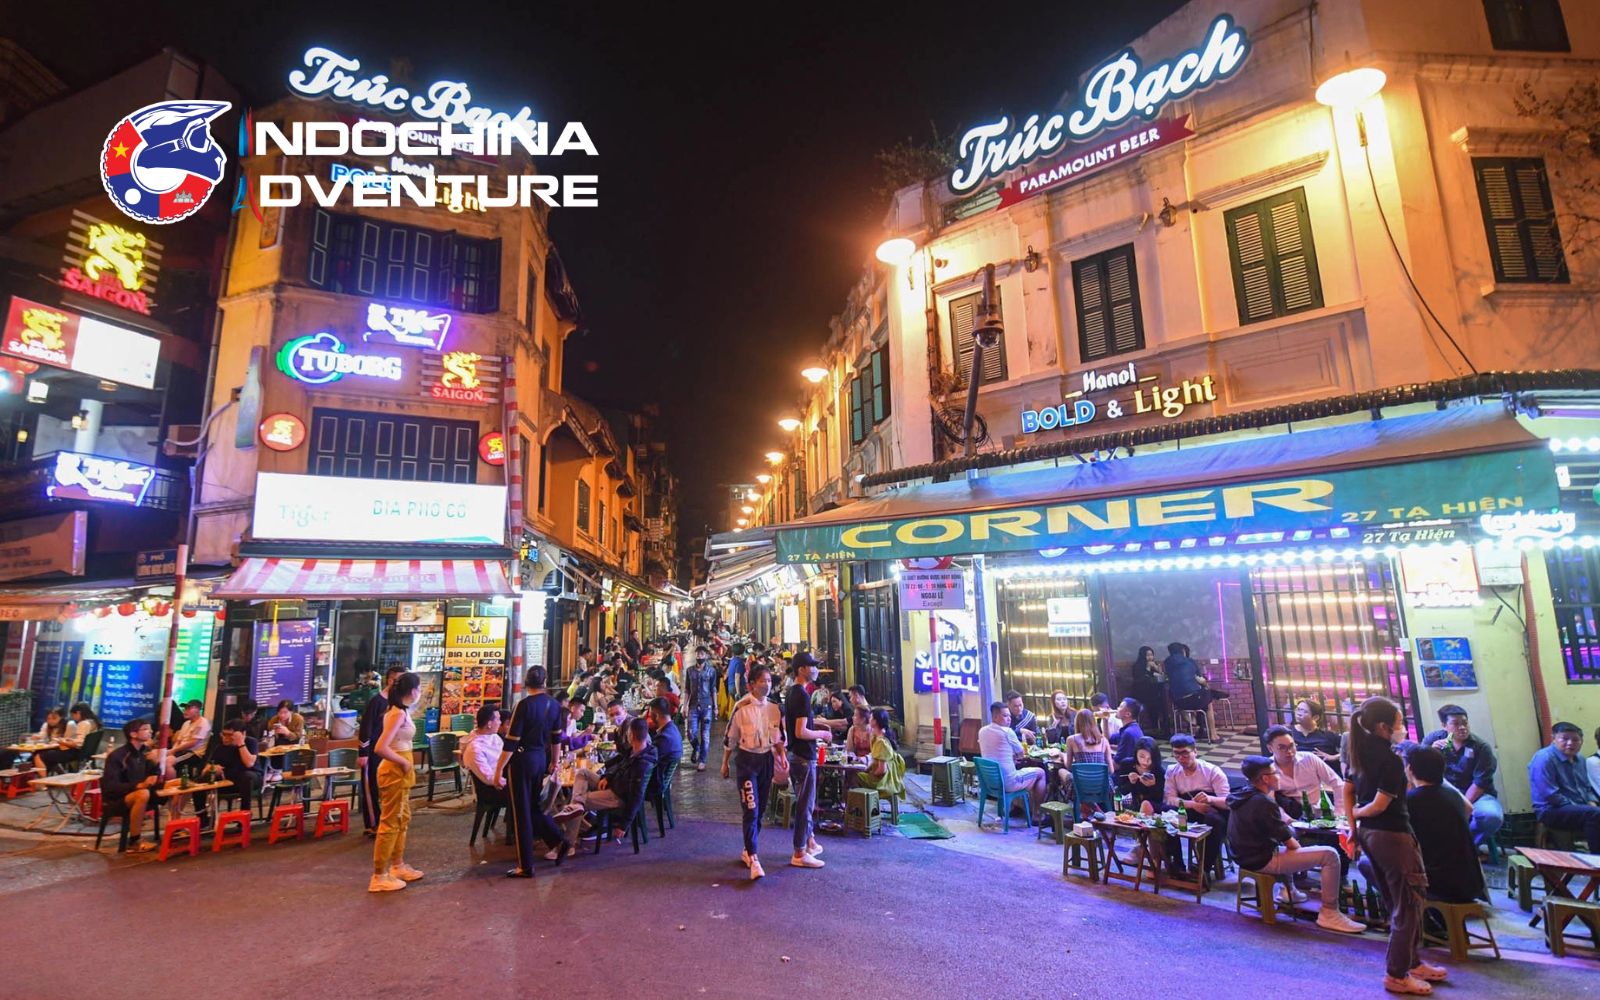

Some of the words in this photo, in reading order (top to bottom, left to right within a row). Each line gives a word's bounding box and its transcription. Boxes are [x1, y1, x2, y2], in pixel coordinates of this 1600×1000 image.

[288, 46, 410, 111] Trúc
[952, 115, 1063, 191] Trúc
[1069, 18, 1245, 137] Bạch
[1019, 144, 1117, 194] PARAMOUNT
[1119, 127, 1160, 155] BEER
[64, 267, 149, 315] SAIGON
[297, 347, 401, 381] TUBORG
[1082, 363, 1137, 393] Hanoi
[432, 386, 485, 401] SAIGON
[1021, 399, 1096, 434] BOLD
[1106, 400, 1123, 419] &
[1133, 375, 1217, 418] Light
[840, 479, 1335, 549] CORNER
[1342, 510, 1376, 523] 27
[1388, 506, 1431, 521] TẠ
[1442, 496, 1524, 515] HIỆN
[1362, 532, 1386, 544] 27
[1389, 531, 1411, 543] Tạ
[1414, 528, 1456, 542] Hiện
[787, 554, 800, 562] 27
[804, 552, 821, 563] TẠ
[456, 634, 495, 644] HALIDA
[944, 639, 966, 652] BIA
[744, 780, 756, 809] BOLD
